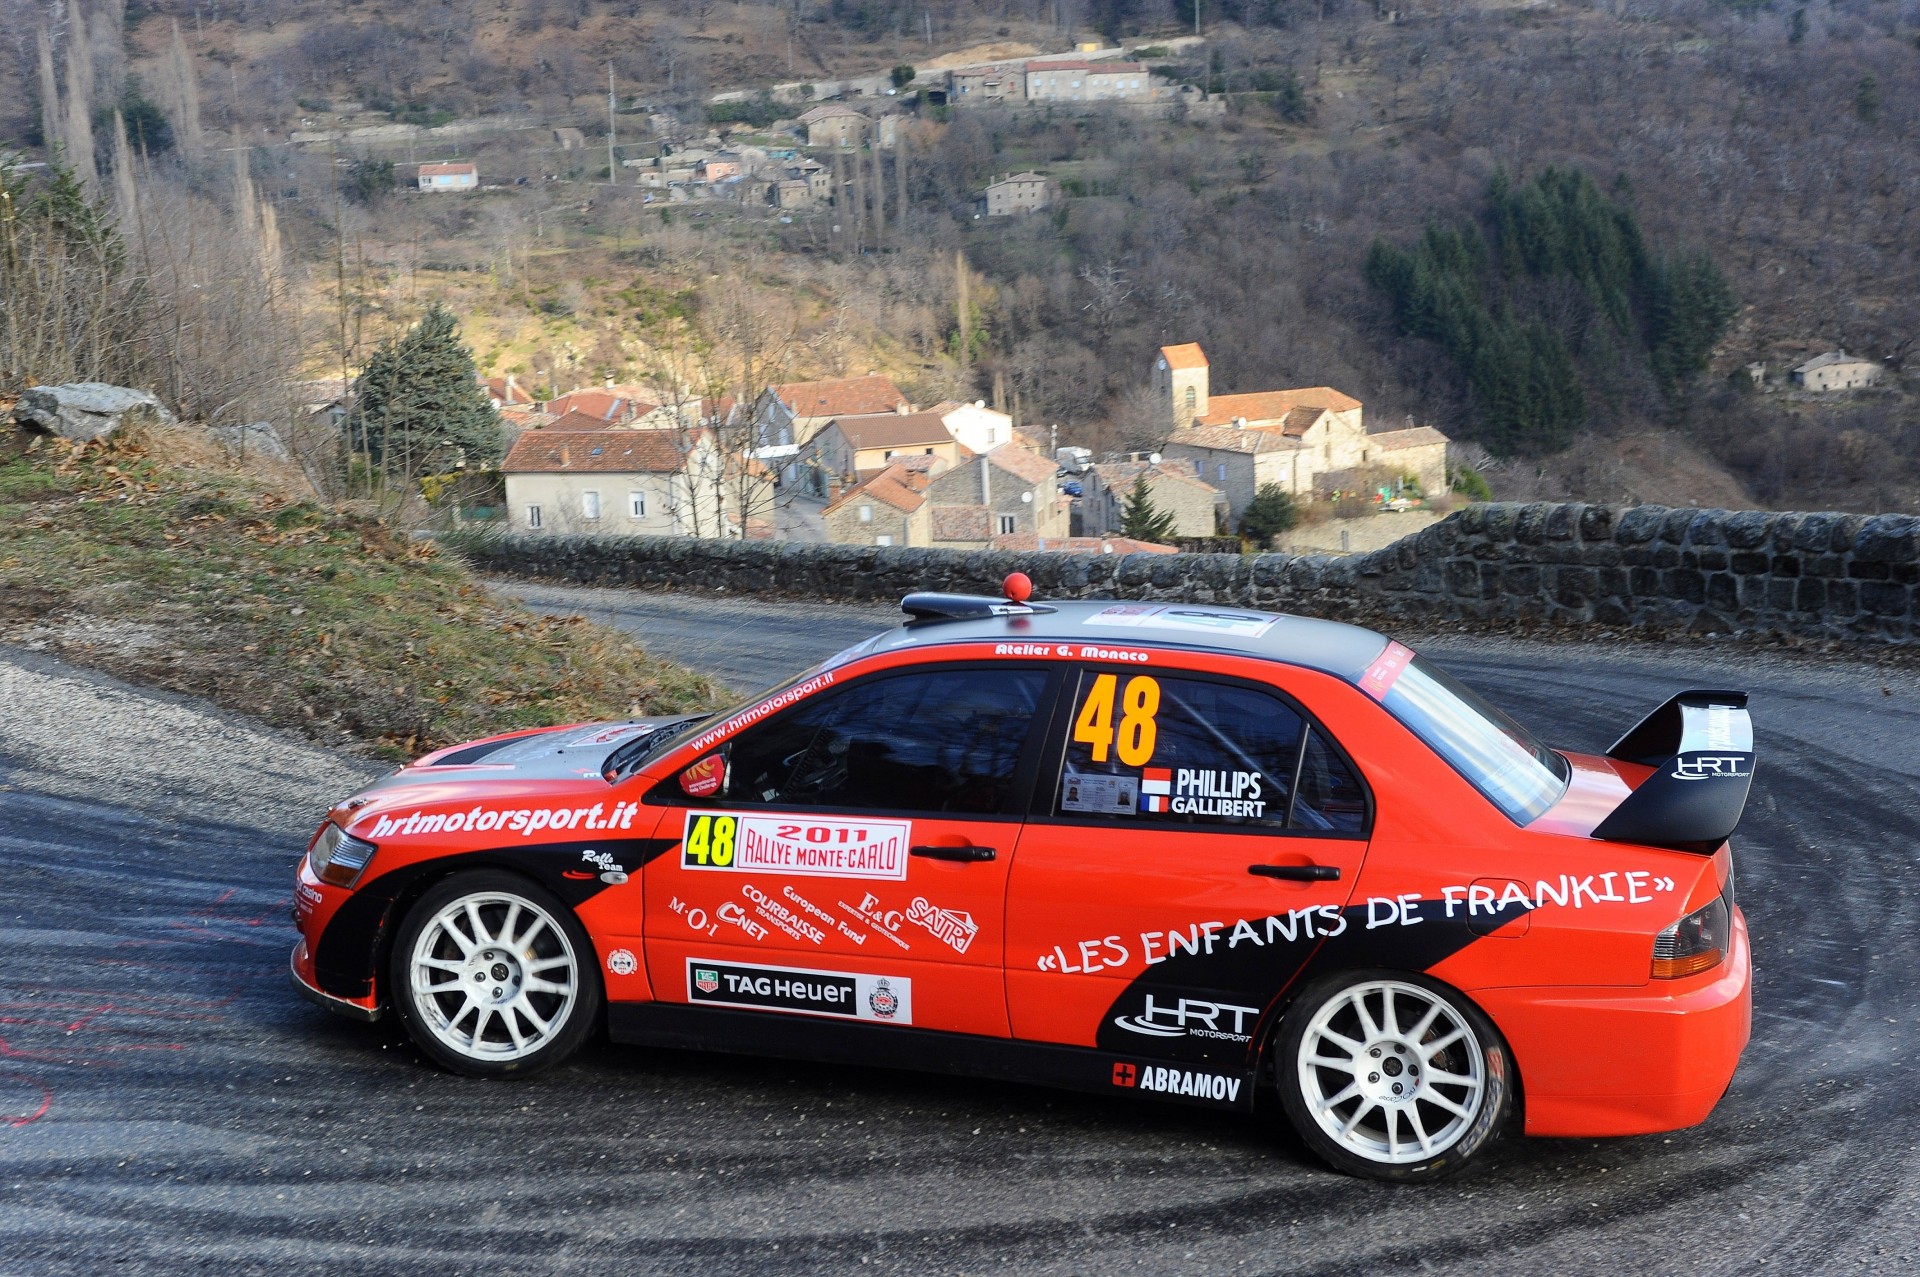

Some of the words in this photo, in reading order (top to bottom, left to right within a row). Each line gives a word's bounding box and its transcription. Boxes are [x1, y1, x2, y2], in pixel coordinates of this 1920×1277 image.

[995, 644, 1050, 657] Atelier
[1056, 646, 1073, 657] G.
[1080, 646, 1148, 662] Monaco
[691, 672, 834, 751] www.hrtmotorsport.it
[1073, 673, 1161, 767] 48
[1176, 768, 1262, 799] PHILLIPS
[1677, 757, 1745, 773] HRT
[367, 801, 639, 839] hrtmotorsport.it
[1171, 796, 1267, 818] GALLIBERT
[687, 815, 736, 867] 48
[745, 828, 792, 865] RALLYE
[776, 825, 868, 844] 2011
[598, 861, 623, 872] Team
[742, 884, 826, 945] COURBAISSE
[755, 906, 802, 941] TRANSPORTS
[783, 886, 836, 926] European
[837, 921, 867, 946] Fund
[1140, 904, 1348, 965] ENFANTS
[1365, 893, 1424, 930] DE
[1145, 994, 1260, 1034] HRT
[1189, 1028, 1253, 1043] MOTORSPORT
[1139, 1065, 1241, 1102] ABRAMOV
